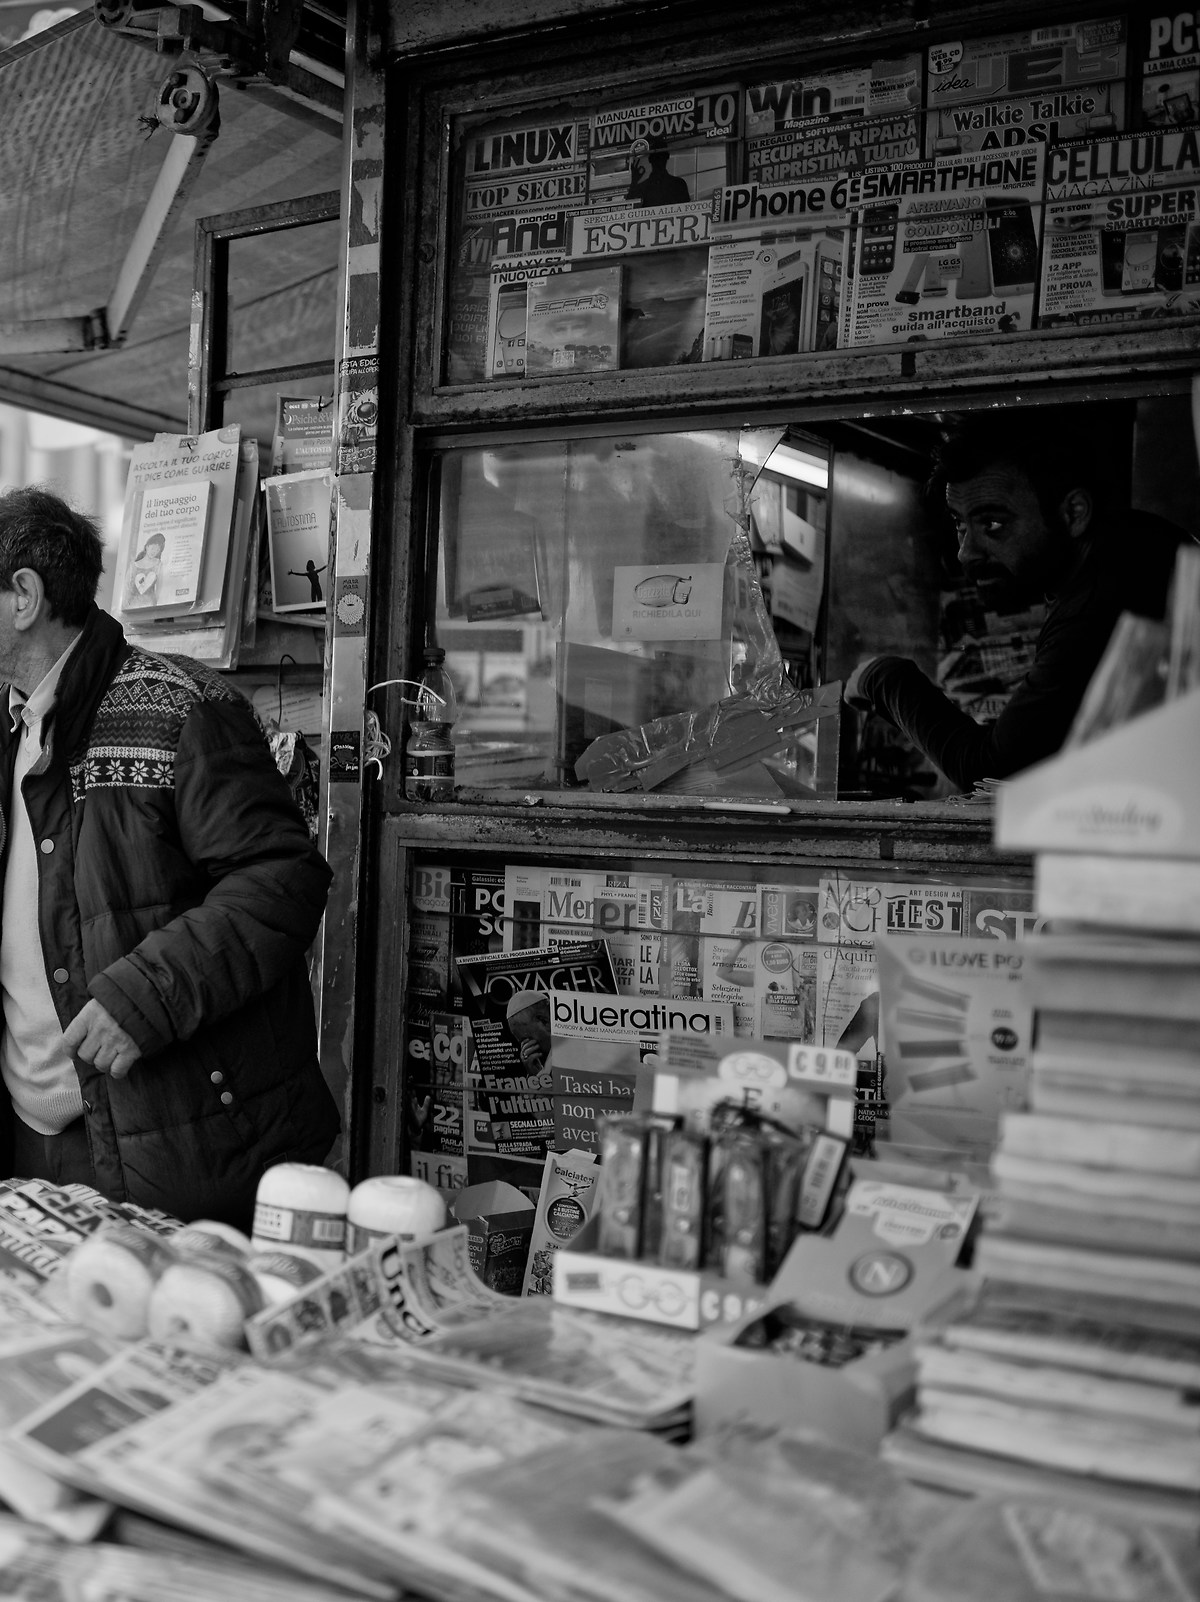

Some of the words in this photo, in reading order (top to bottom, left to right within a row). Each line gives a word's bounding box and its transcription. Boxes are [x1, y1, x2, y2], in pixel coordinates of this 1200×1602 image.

[931, 52, 948, 62] WEB
[949, 49, 960, 58] CD
[932, 74, 976, 93] idea
[748, 82, 831, 121] Win
[597, 107, 646, 125] MANUALE
[648, 100, 693, 116] PRATICO
[696, 93, 736, 131] 10
[952, 104, 1025, 133] Walkie
[1029, 94, 1096, 122] Talkie
[596, 112, 695, 146] WINDOWS
[783, 115, 830, 130] Magazine
[749, 141, 758, 150] IN
[758, 134, 794, 148] REGALO
[804, 122, 852, 138] SOFTWARE
[750, 135, 844, 167] RECUPERA,
[850, 120, 918, 147] RIPARA
[1058, 140, 1085, 148] MENSILE
[1094, 136, 1120, 144] MOBILE
[1120, 129, 1166, 140] TECHNOLOGY
[474, 126, 573, 172] LINUX
[761, 149, 858, 182] RIPRISTINA
[862, 137, 918, 166] TUTTO
[936, 158, 962, 168] CELLULARI
[963, 156, 982, 164] TABLET
[982, 152, 1010, 162] ACCESSORI
[862, 156, 1038, 199] SMARTPHONE
[1002, 180, 1037, 190] MAGAZINE
[468, 187, 510, 210] TOP
[724, 185, 826, 222] iPhone
[906, 196, 982, 215] ARRIVANO
[1066, 203, 1092, 212] STORY
[1106, 188, 1196, 220] SUPER
[466, 212, 491, 220] DOSSIER
[491, 210, 515, 219] HACKER
[520, 213, 556, 224] mondo
[584, 213, 626, 225] SPECIALE
[627, 208, 656, 219] GUIDA
[658, 205, 682, 216] ALLA
[1104, 212, 1196, 232] SMARTPHONE
[904, 216, 1000, 238] COMPONIBILI
[937, 235, 973, 245] smartphone
[1048, 264, 1060, 272] 12
[1062, 262, 1082, 270] APP
[1047, 284, 1057, 292] IN
[1060, 280, 1092, 290] PROVA
[866, 300, 890, 308] prova
[908, 302, 1007, 322] smartband
[892, 322, 925, 334] guida
[133, 460, 168, 472] ASCOLTA
[181, 456, 200, 464] TUO
[134, 474, 142, 483] TI
[144, 472, 162, 482] DICE
[164, 468, 190, 479] COME
[192, 462, 231, 474] GUARIRE
[153, 494, 198, 508] linguaggio
[144, 510, 158, 519] del
[175, 505, 200, 515] corpo
[632, 609, 683, 618] RICHIEDILA
[684, 608, 702, 618] QUI
[924, 890, 949, 898] DESIGN
[480, 954, 500, 962] UFFICIALE
[509, 949, 540, 958] PROGRAMMA
[600, 1028, 638, 1036] MANAGEMENT
[560, 1074, 603, 1095] Tassi
[433, 1104, 460, 1128] 22
[562, 1104, 596, 1120] non
[434, 1126, 460, 1136] pagine
[510, 1120, 537, 1129] SEGNALI
[554, 1166, 595, 1185] Calciatori
